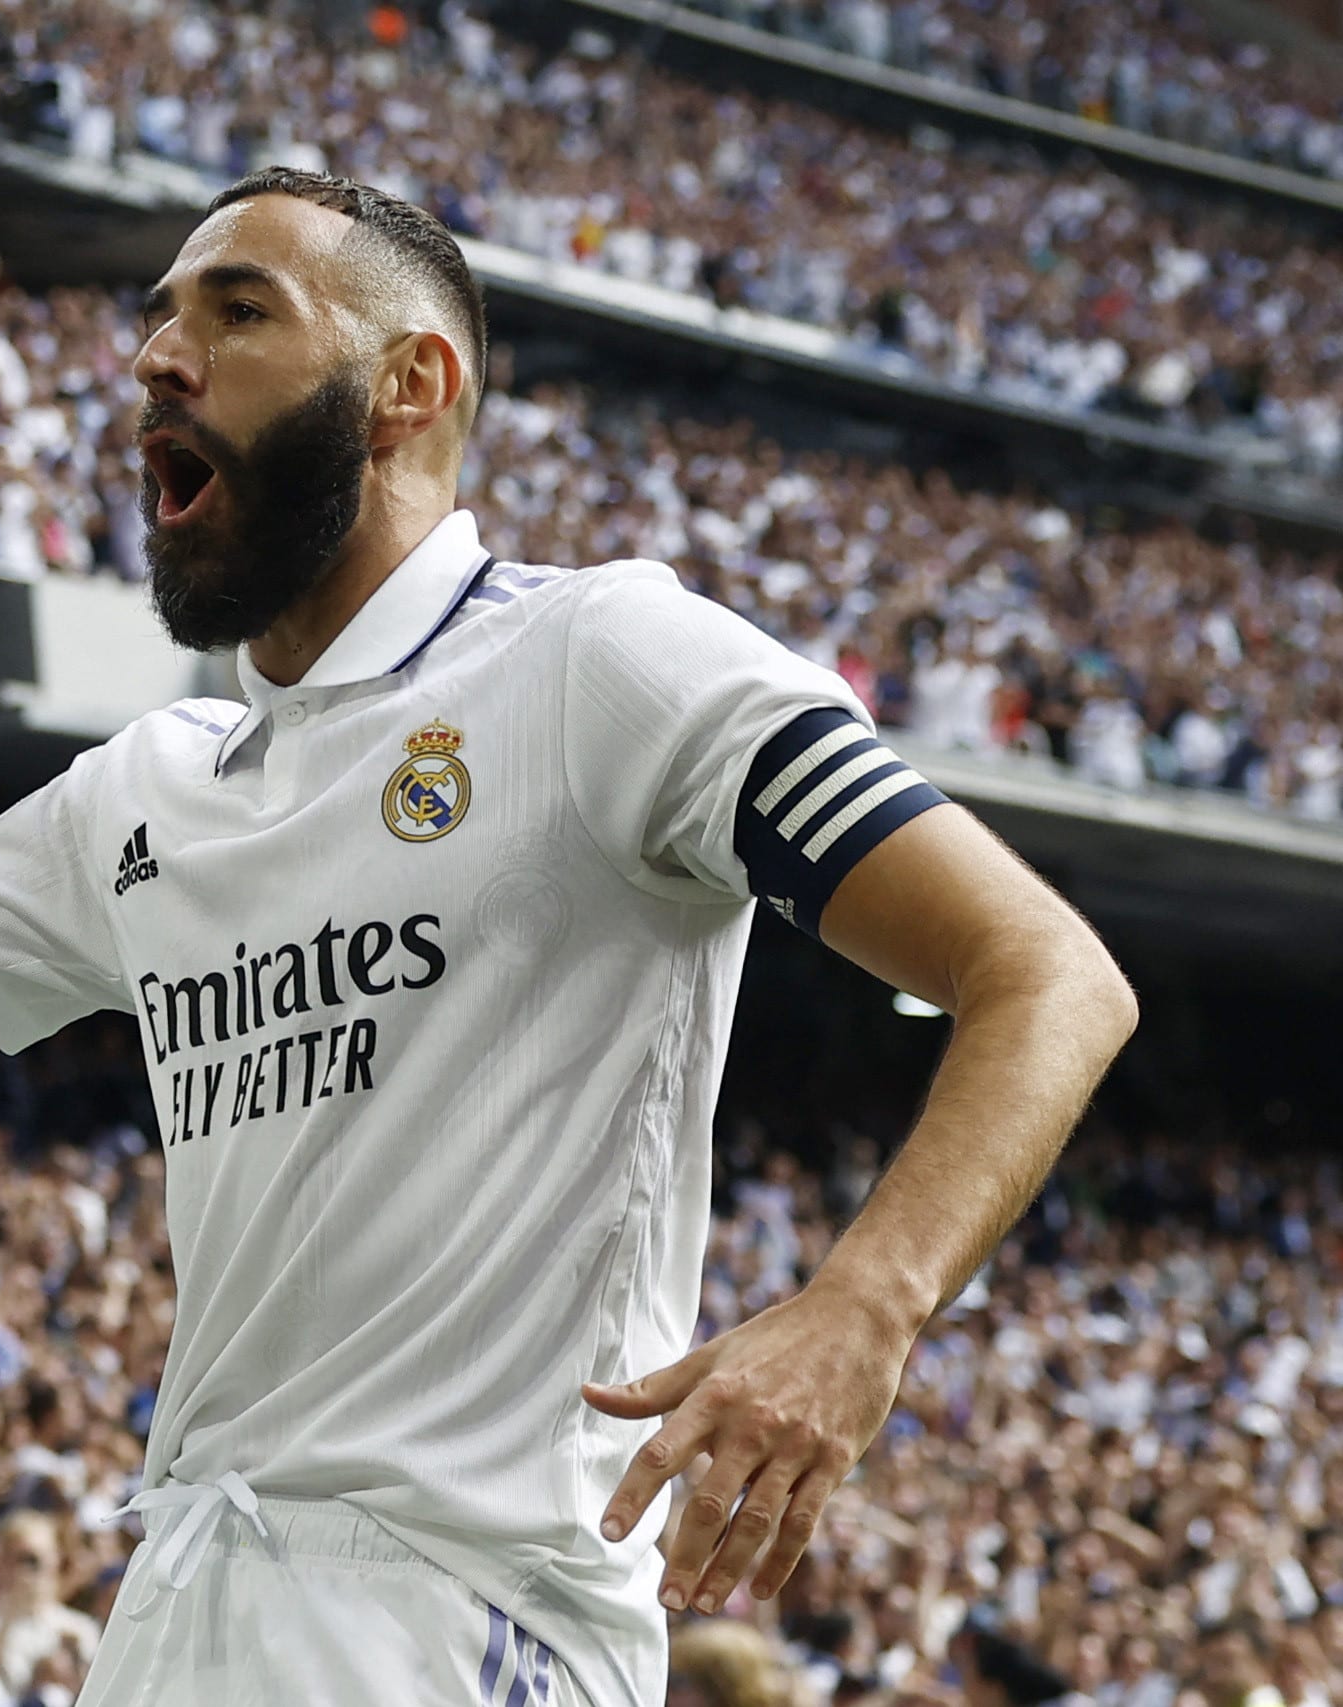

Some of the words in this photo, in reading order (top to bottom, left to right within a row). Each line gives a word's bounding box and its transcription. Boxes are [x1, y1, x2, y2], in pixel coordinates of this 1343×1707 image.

[114, 858, 159, 897] adidas
[139, 913, 447, 1066] Emirates
[168, 1060, 225, 1148] FLY
[230, 1017, 377, 1128] BETTER
